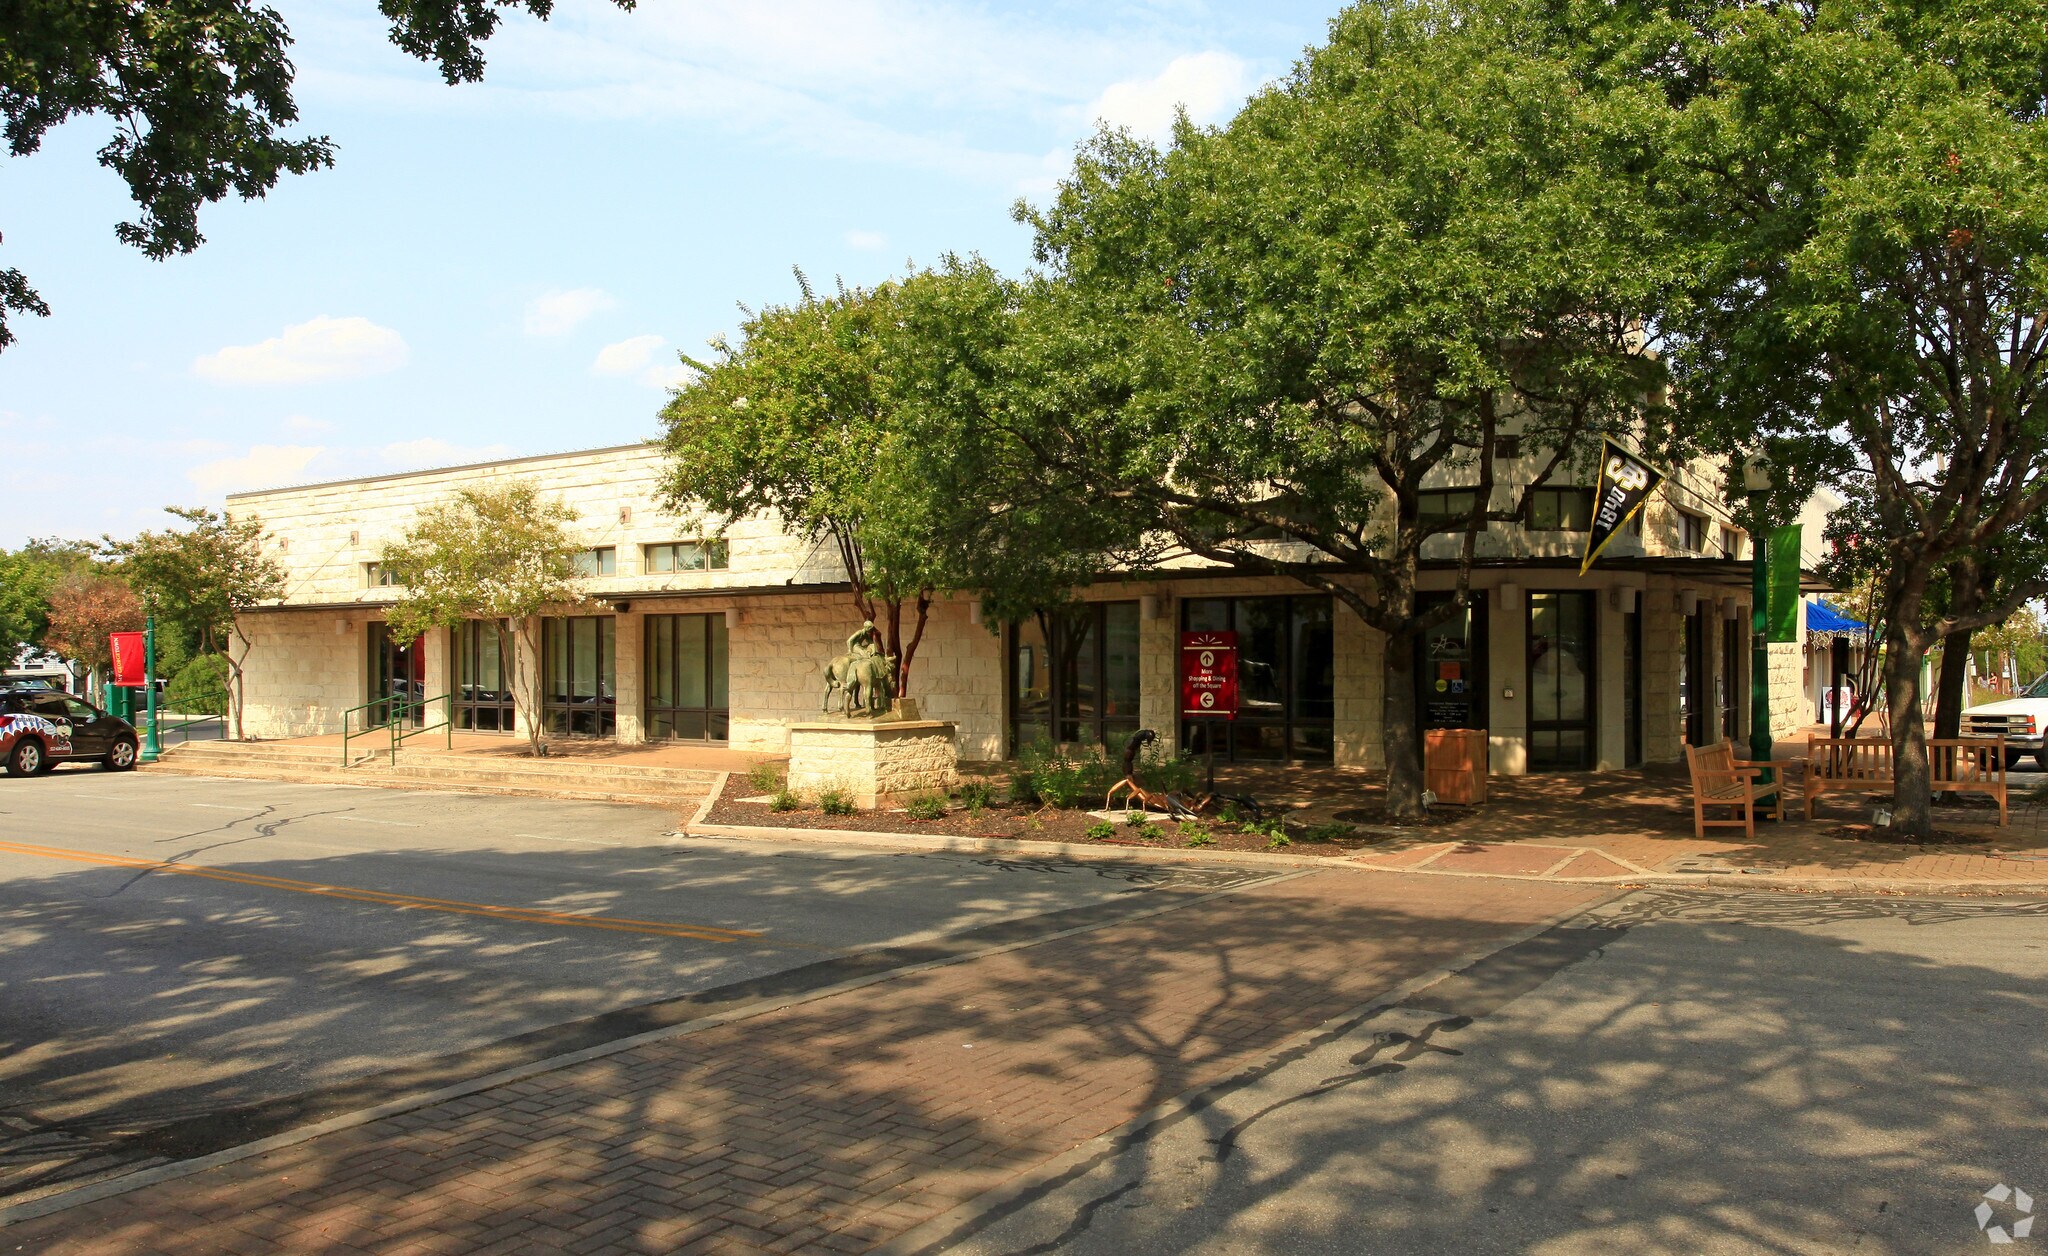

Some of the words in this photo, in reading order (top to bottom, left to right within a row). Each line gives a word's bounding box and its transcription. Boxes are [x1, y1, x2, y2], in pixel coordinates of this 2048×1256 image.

[1596, 486, 1626, 531] 1840
[114, 637, 122, 673] GEORGETOWN
[118, 674, 123, 682] MY
